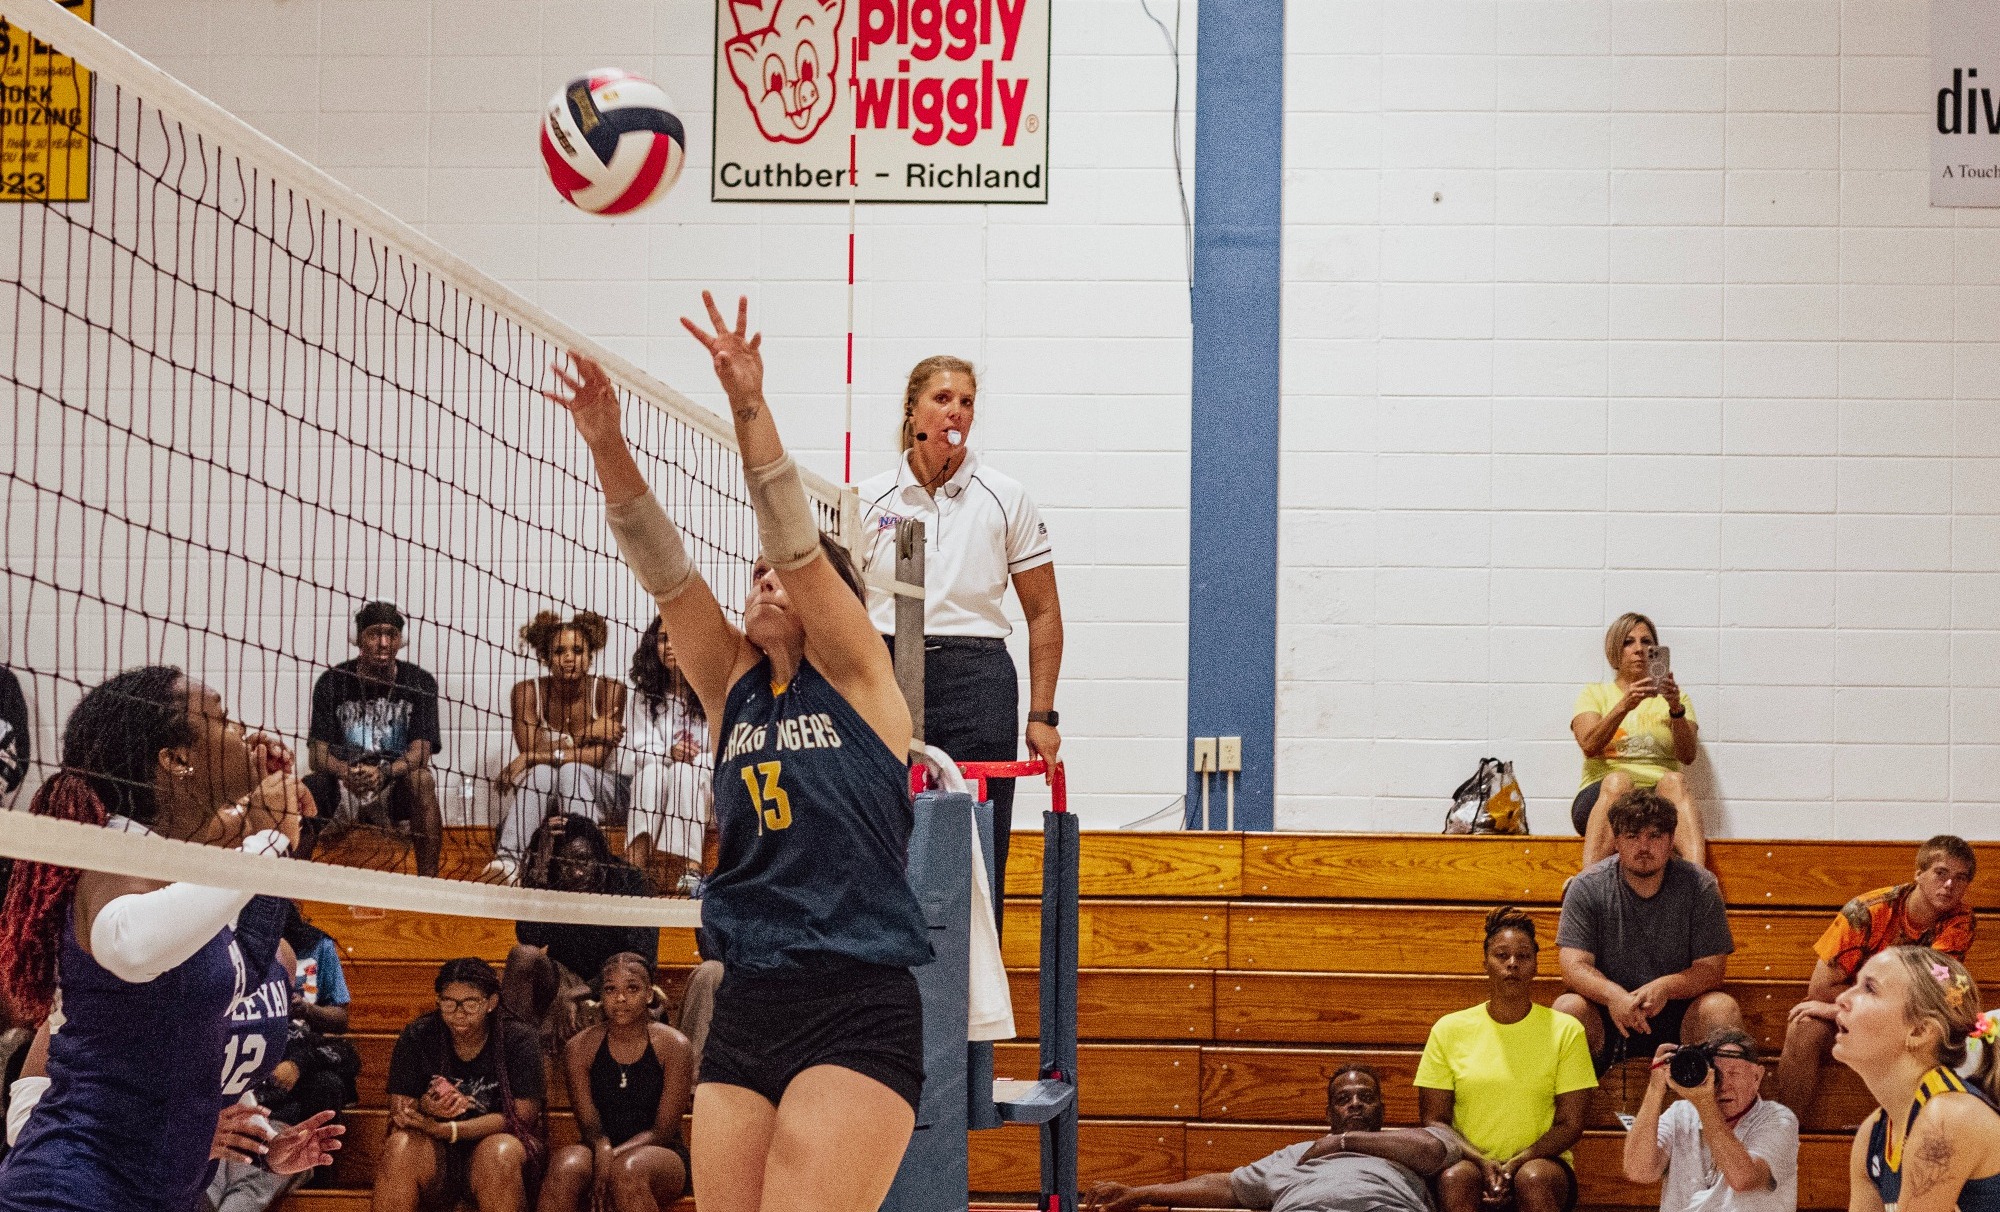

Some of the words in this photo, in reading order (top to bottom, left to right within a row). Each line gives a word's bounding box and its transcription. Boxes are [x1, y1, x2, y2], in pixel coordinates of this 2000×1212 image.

[858, 0, 1025, 61] piggly
[849, 59, 1029, 147] wiggly
[1937, 68, 2000, 134] div
[906, 164, 1040, 188] Richland
[1942, 166, 1954, 179] A
[741, 760, 792, 836] 13
[221, 1034, 267, 1095] 12
